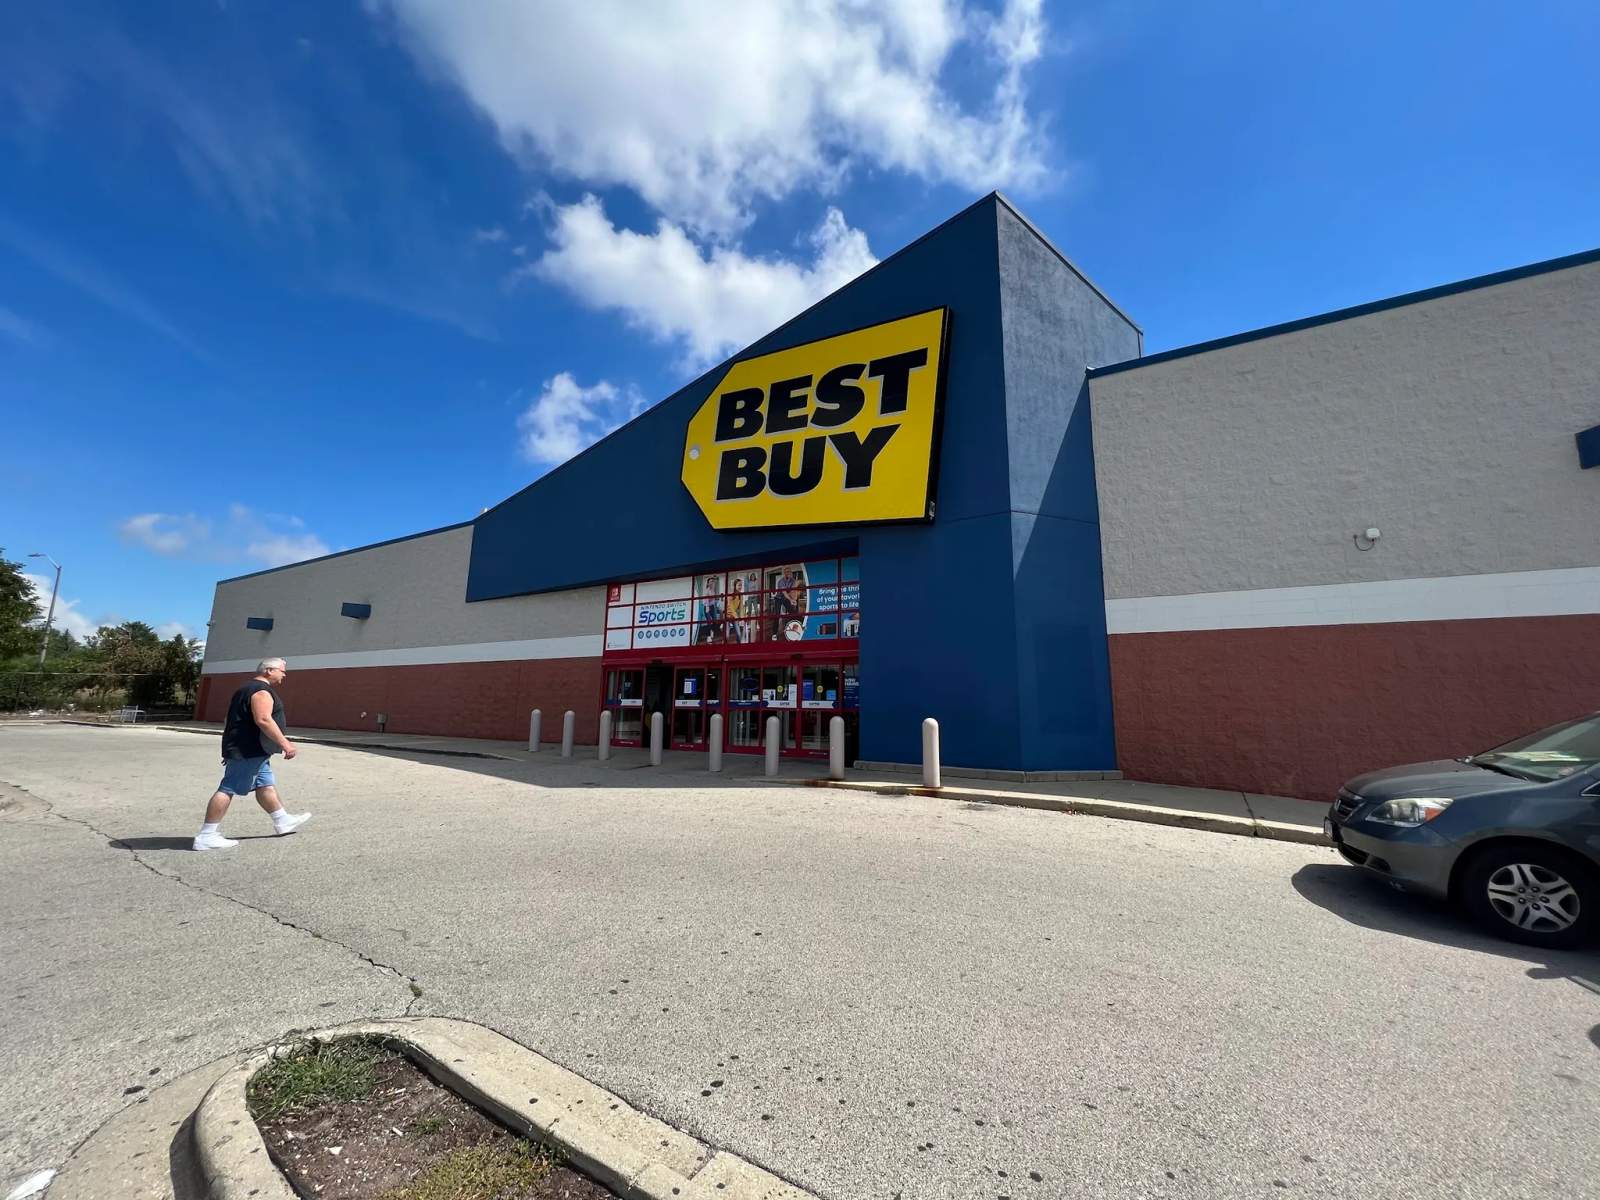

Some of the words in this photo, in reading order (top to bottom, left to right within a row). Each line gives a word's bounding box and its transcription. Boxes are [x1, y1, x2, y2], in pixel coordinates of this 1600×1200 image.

[714, 346, 929, 443] BEST
[715, 423, 902, 501] BUY
[818, 588, 836, 596] Bring
[639, 608, 686, 625] Sports
